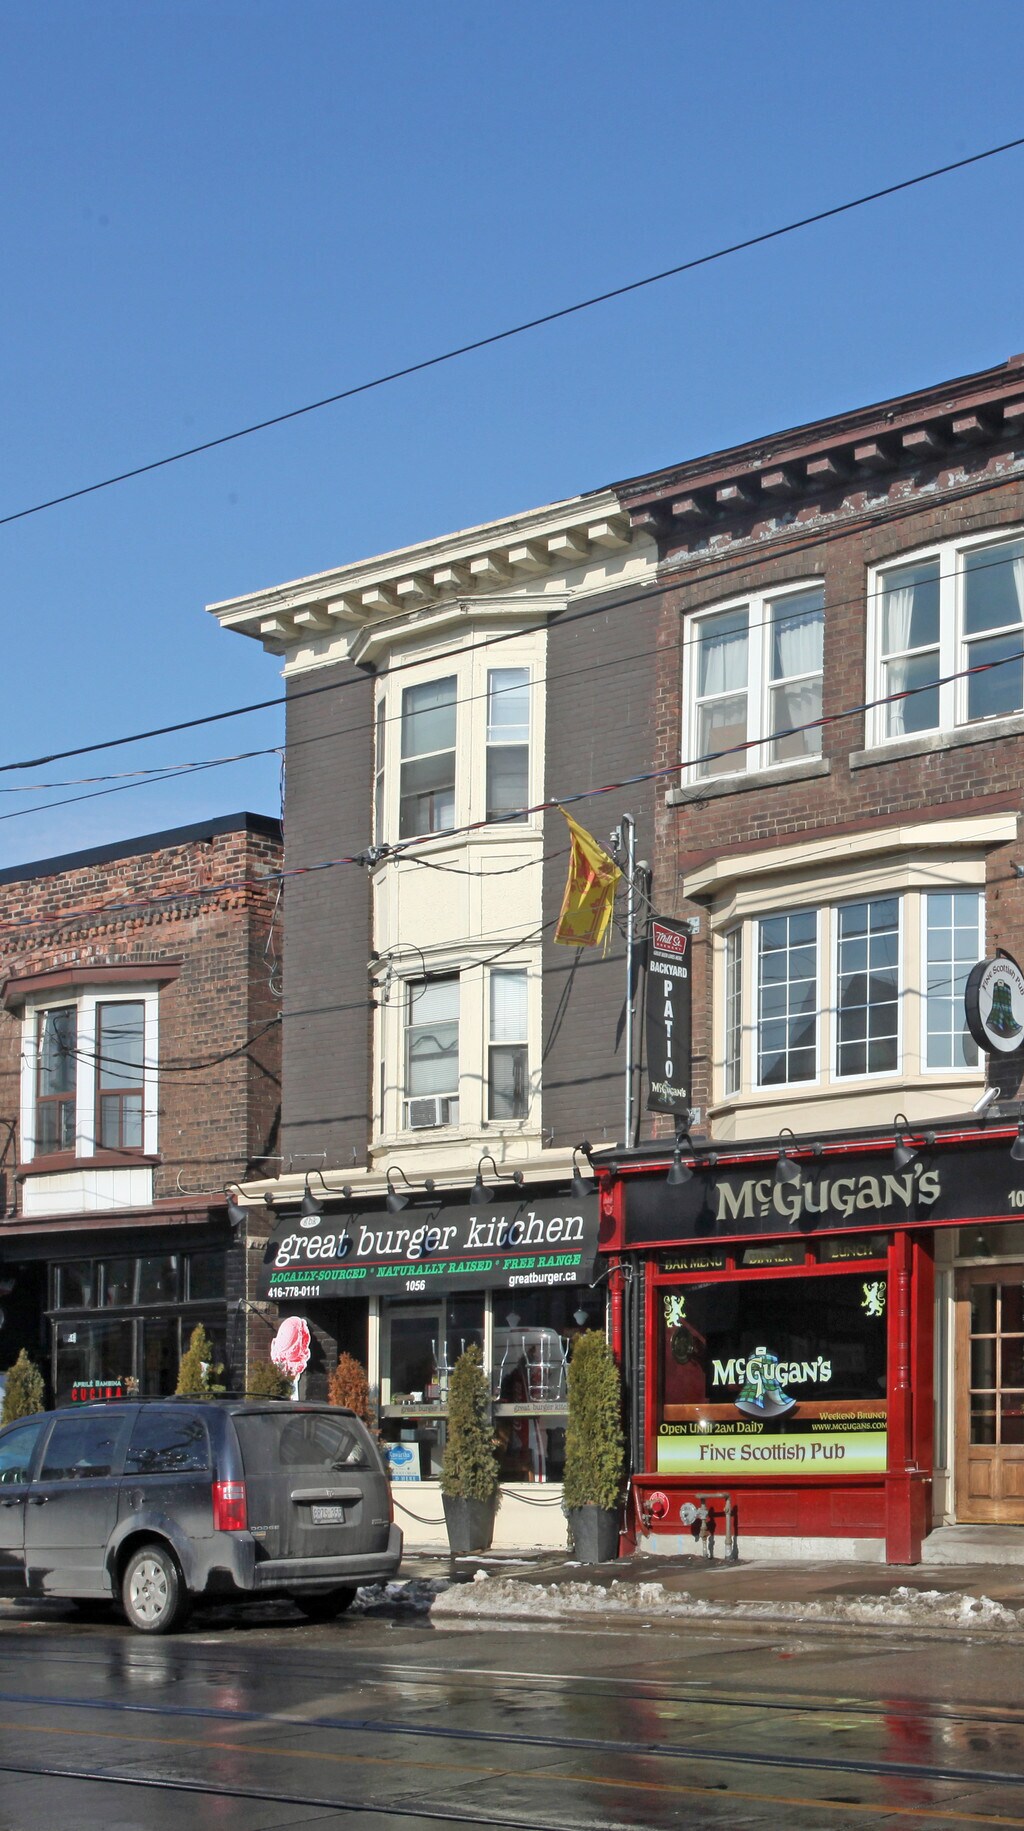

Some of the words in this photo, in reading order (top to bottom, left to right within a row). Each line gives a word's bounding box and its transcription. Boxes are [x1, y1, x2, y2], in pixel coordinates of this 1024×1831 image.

[656, 932, 672, 944] Mill
[650, 961, 687, 978] BACKYARD
[1015, 976, 1024, 996] Pub
[663, 979, 674, 1078] PATIO
[275, 1228, 349, 1267] great
[357, 1225, 457, 1259] burger
[463, 1212, 584, 1249] kitchen
[270, 1268, 366, 1283] LOCALLY-SOURCED
[376, 1263, 446, 1278] NATURALLY
[448, 1260, 492, 1274] RAISED
[502, 1256, 534, 1270] FREE
[537, 1253, 581, 1267] RANGE
[664, 1258, 688, 1270] BAR
[690, 1256, 722, 1268] MENU
[268, 1285, 320, 1298] 416-778-0111
[405, 1279, 426, 1292] 1056
[509, 1271, 577, 1287] greatburger.ca
[737, 1421, 764, 1433] Daily
[741, 1442, 805, 1462] Scottish
[811, 1442, 845, 1460] Pub
